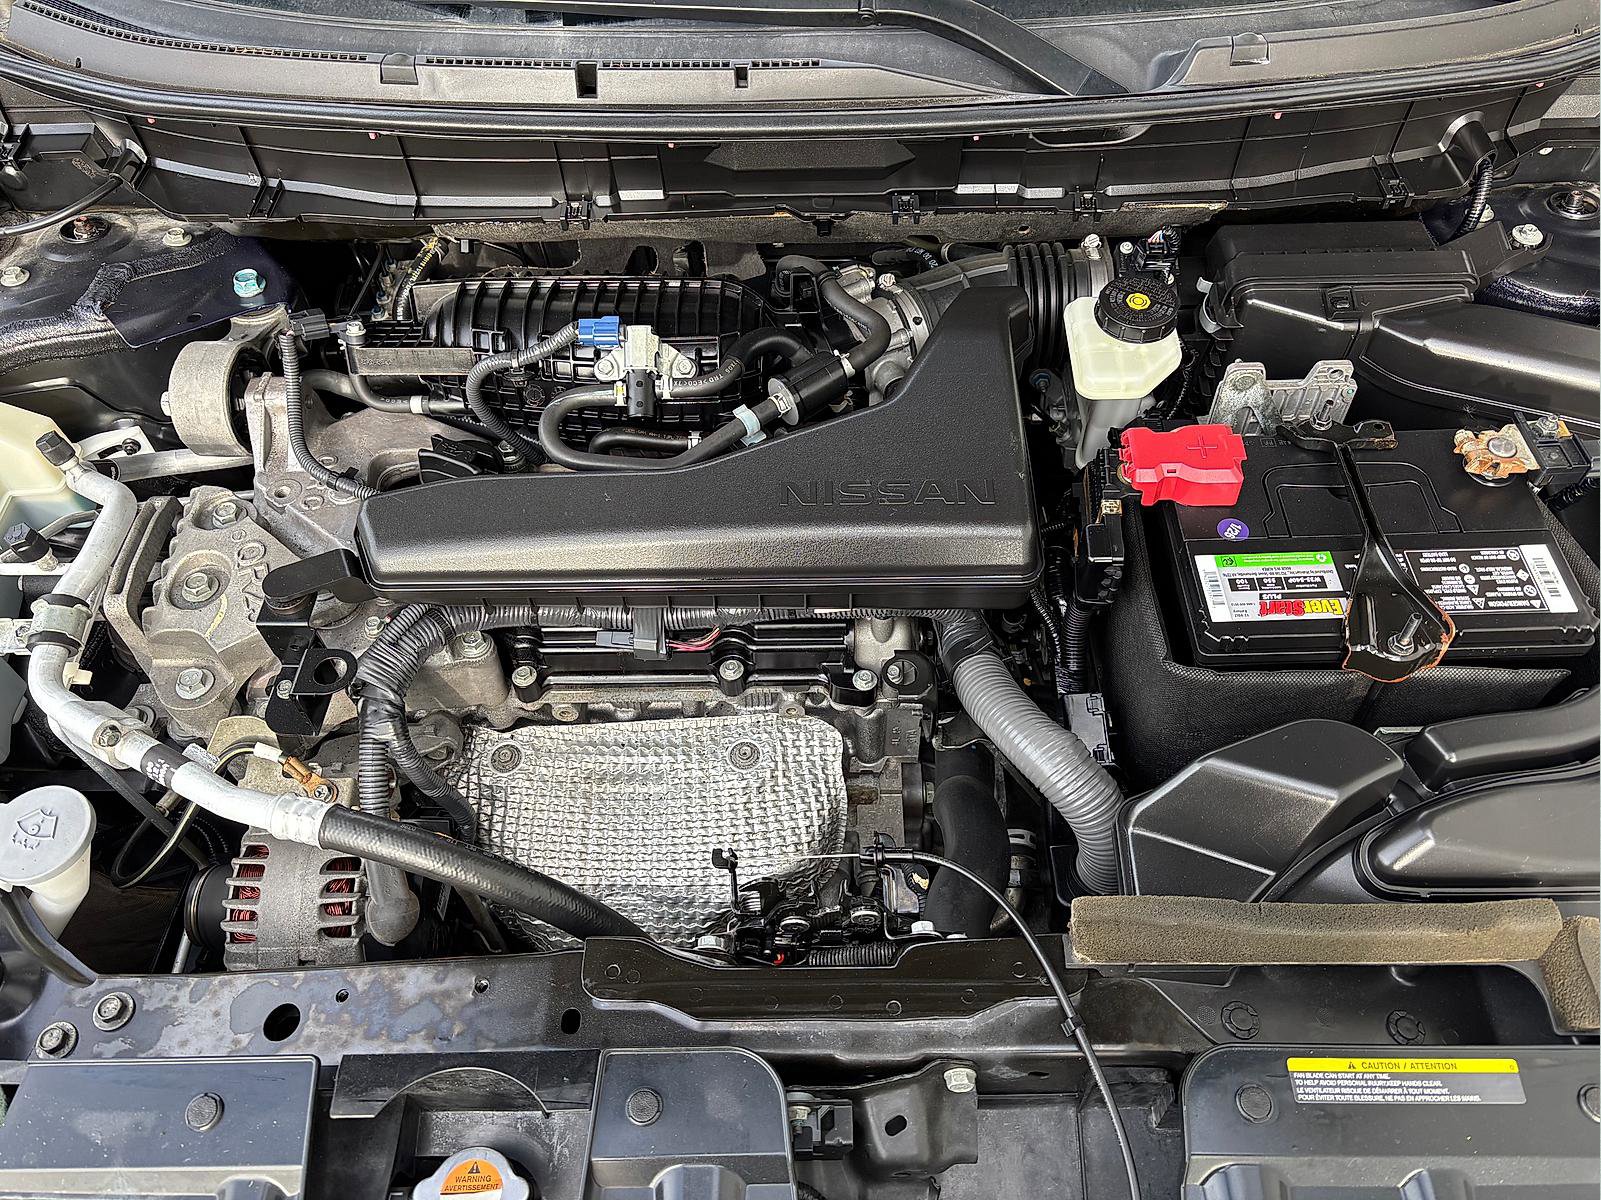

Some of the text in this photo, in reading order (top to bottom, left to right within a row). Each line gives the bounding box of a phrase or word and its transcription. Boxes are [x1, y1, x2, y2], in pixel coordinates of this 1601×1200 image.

[779, 478, 996, 507] NISSAN
[1259, 599, 1344, 617] EverStart
[1361, 1061, 1401, 1070] CAUTION
[1410, 1062, 1458, 1071] ATTENTION
[455, 1175, 492, 1183] WARNING
[444, 1183, 499, 1192] AVERTISSEMENT
